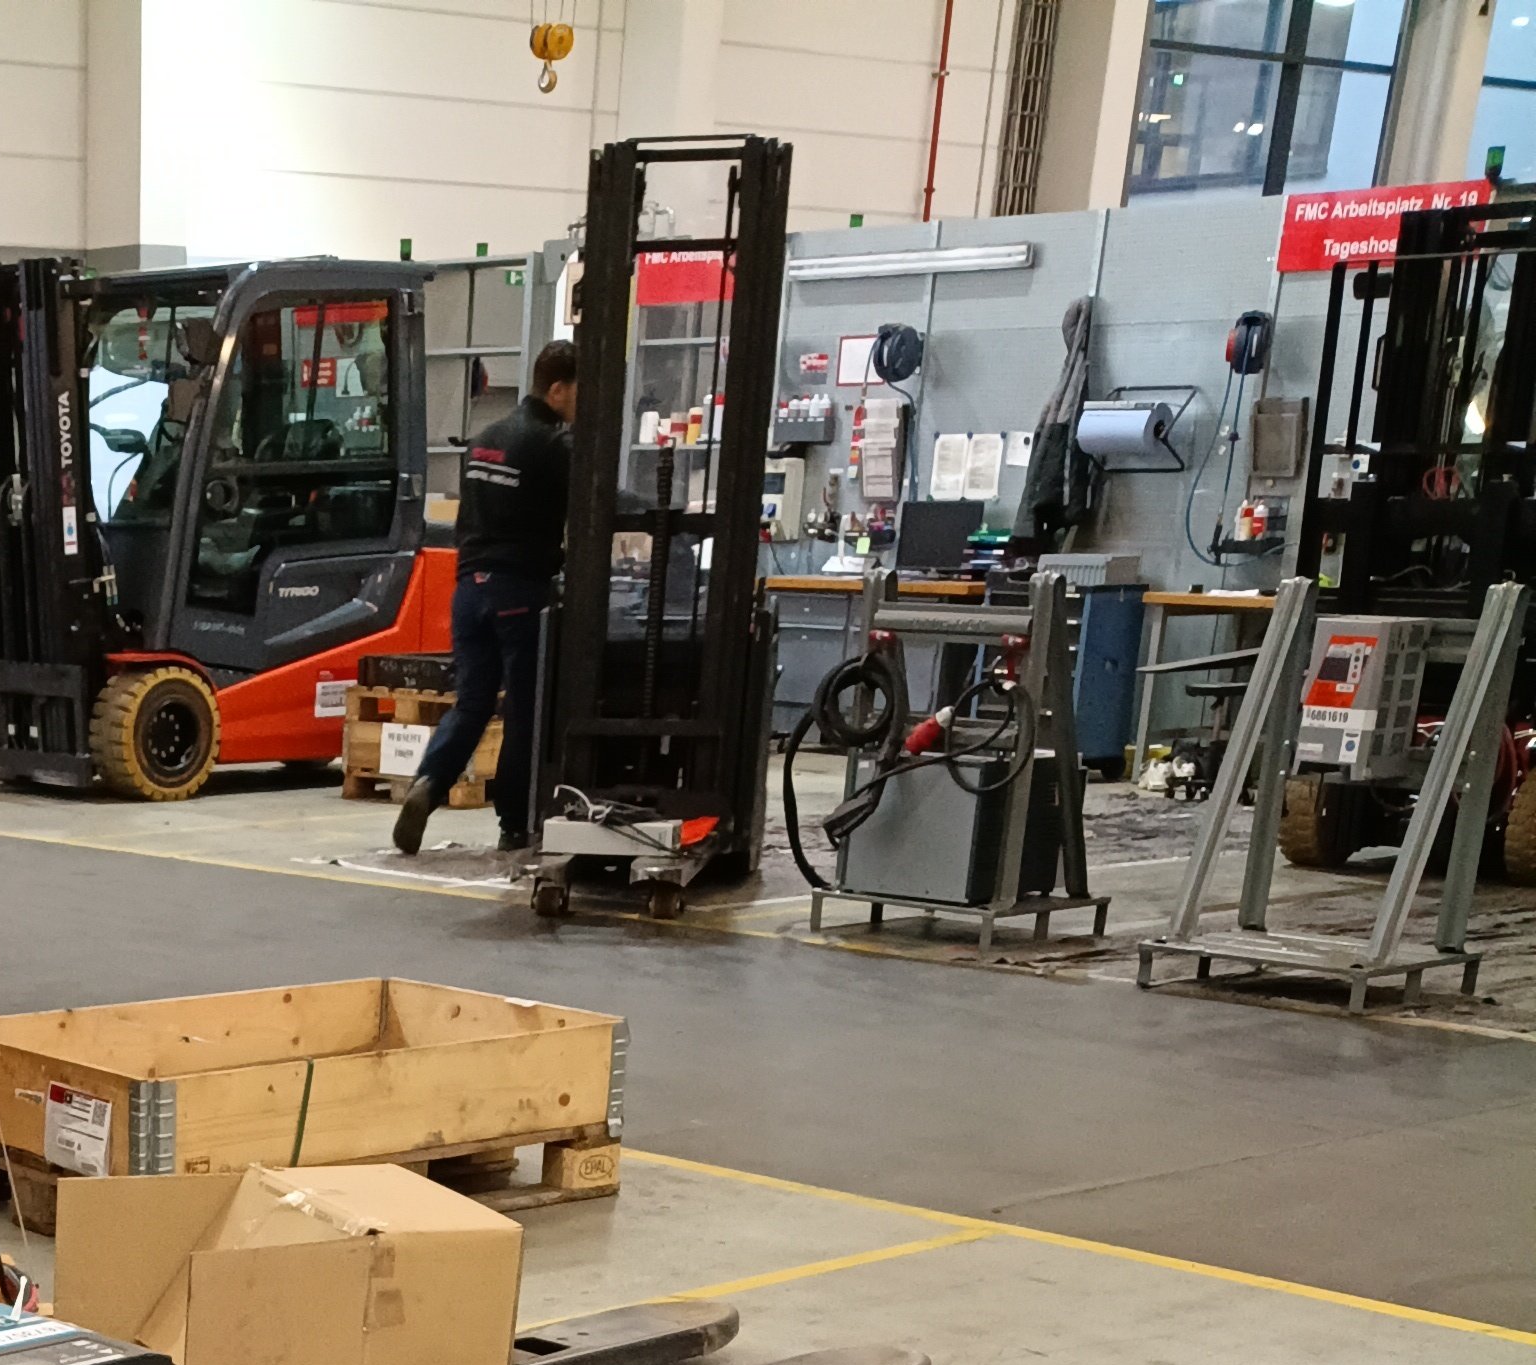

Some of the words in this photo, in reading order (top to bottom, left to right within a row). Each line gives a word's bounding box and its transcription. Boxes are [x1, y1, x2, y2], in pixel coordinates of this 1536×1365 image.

[1295, 201, 1329, 222] FMC
[1331, 196, 1424, 220] Arbeitsplatz
[1324, 236, 1398, 259] Tageshos
[57, 390, 73, 469] TOYOTA
